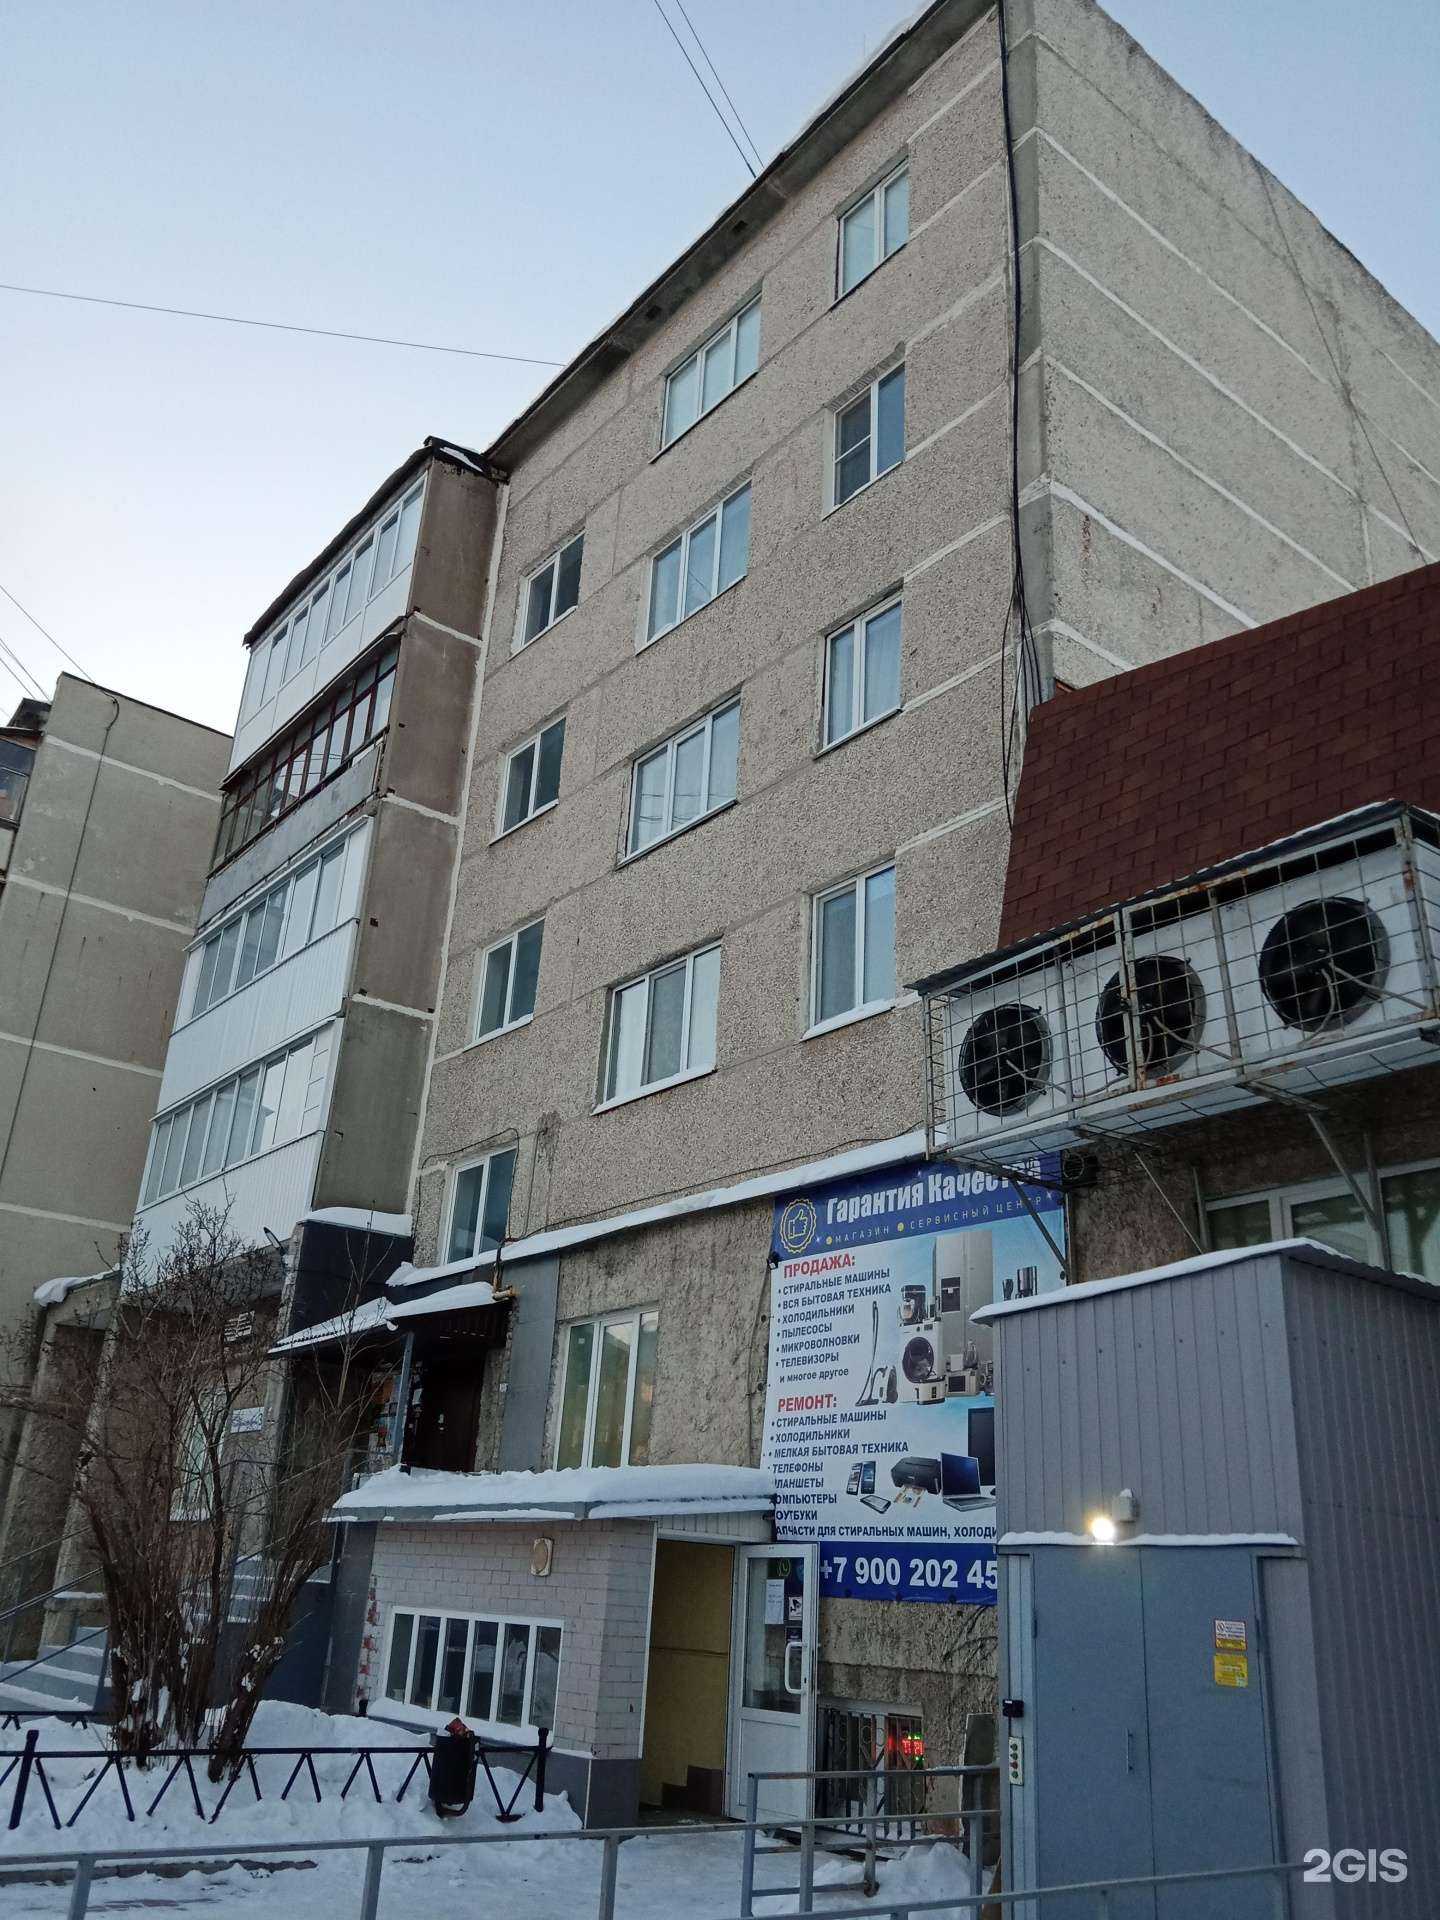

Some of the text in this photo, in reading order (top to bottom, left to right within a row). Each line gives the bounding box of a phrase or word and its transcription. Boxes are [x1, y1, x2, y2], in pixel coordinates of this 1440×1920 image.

[827, 1182, 924, 1224] Гарантия
[836, 1196, 1042, 1243] МАГАЗИН СЕРВИСНЫЙ ЦЕНР
[784, 1253, 856, 1278] ПРОДАЖА:
[783, 1268, 890, 1296] СТИРАЛЬНЫЕ МАШИНЫ
[783, 1283, 892, 1310] ВСЯ БЫТОВАЯ ТЕХНИКА
[782, 1304, 855, 1325] ХОЛОДИЛЬНИКИ
[782, 1323, 833, 1339] ПЫЛЕСОСЫ
[781, 1334, 860, 1354] МИКРОВОЛНОВКИ
[780, 1352, 839, 1368] ТЕЛЕВИЗОРЫ
[787, 1371, 817, 1382] многое
[819, 1368, 849, 1381] другое
[777, 1393, 837, 1412] РЕМОНТ:
[776, 1410, 887, 1428] СТИРАЛЬНЫЕ МАШИНЫ
[775, 1428, 850, 1443] ХОЛОДИЛЬНИКИ
[774, 1441, 909, 1458] МЕЛКАЯ БЫТОВАЯ ТЕХНИКА
[772, 1462, 824, 1474] ТЕЛЕФОНЫ
[775, 1494, 837, 1505] ОМПЬЮТЕРЫ
[776, 1510, 818, 1521] ОУТБУКИ
[776, 1525, 815, 1536] АПЧАСТИ
[817, 1525, 836, 1538] ДЛЯ
[838, 1525, 905, 1537] СТИРАЛЬНЫХ
[907, 1526, 951, 1540] МАШИН,
[820, 1556, 997, 1590] +7 900 202 45
